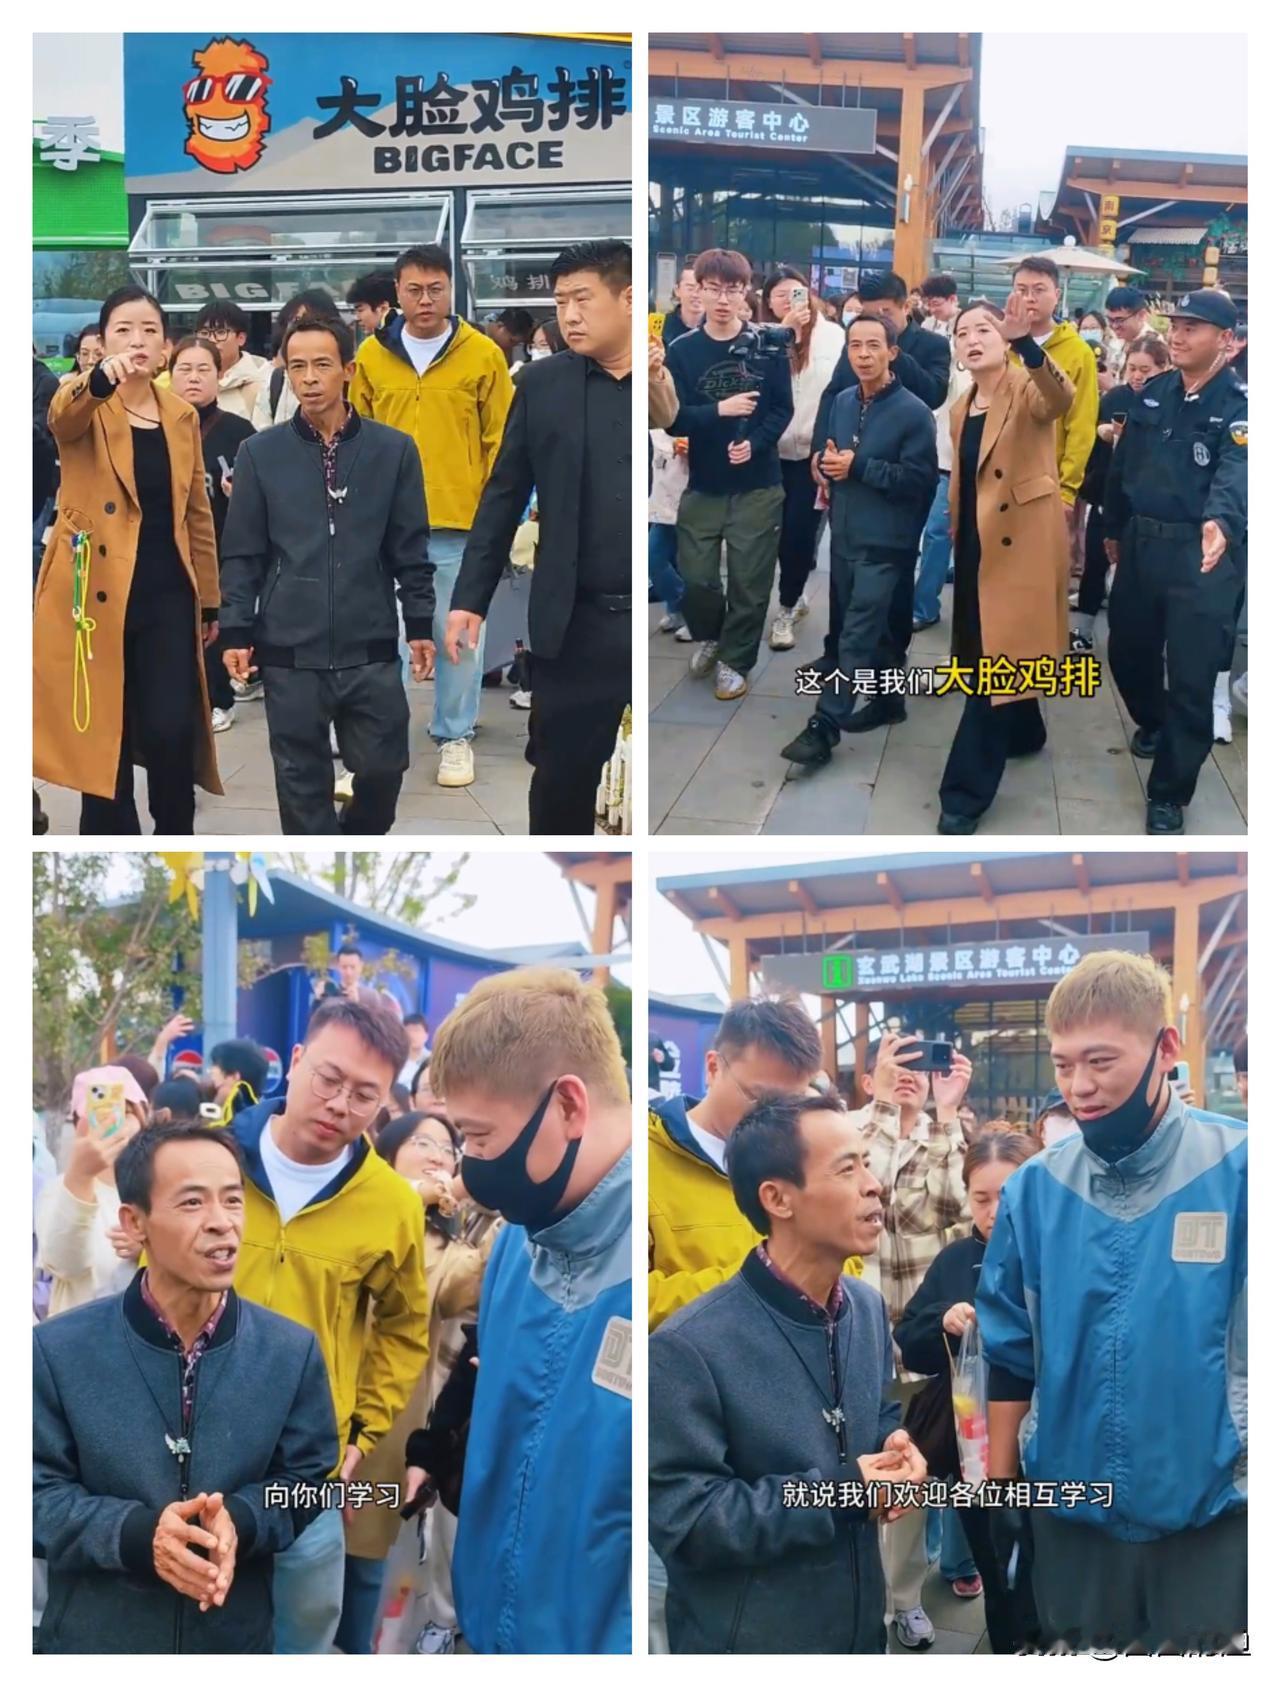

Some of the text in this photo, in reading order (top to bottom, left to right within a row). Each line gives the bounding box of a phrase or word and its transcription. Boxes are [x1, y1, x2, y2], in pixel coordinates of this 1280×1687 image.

[313, 65, 627, 139] 大脸鸡排
[655, 104, 810, 133] 景区游客中心
[40, 115, 101, 171] 季
[652, 125, 809, 143] Scenic Area Tourist Center
[373, 140, 564, 174] BIGFACE
[856, 943, 1080, 976] 玄武湖景区游客中心
[966, 969, 992, 980] Area
[996, 967, 1035, 978] Tourist
